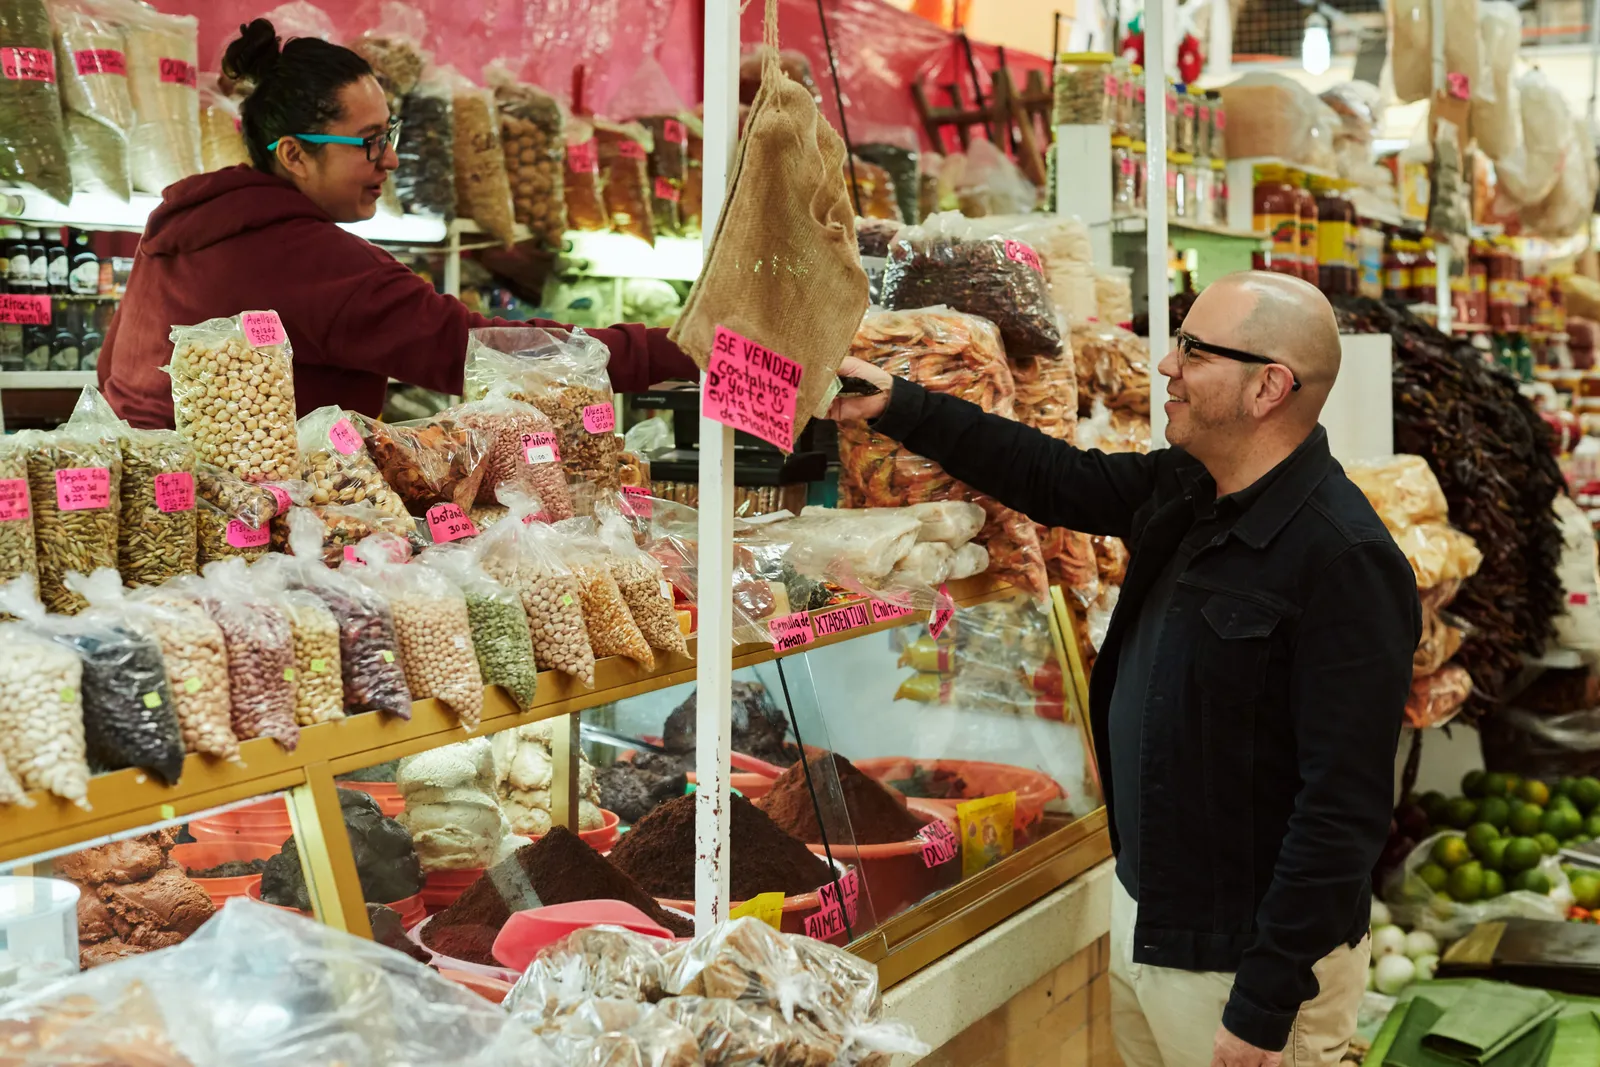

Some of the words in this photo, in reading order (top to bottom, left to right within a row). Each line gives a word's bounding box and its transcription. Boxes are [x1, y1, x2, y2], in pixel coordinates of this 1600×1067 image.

[716, 333, 737, 357] SE
[743, 342, 802, 388] VENDEN
[709, 389, 747, 412] evita
[751, 403, 790, 434] bolsas
[720, 408, 735, 422] de
[815, 603, 869, 634] XTABENTUN
